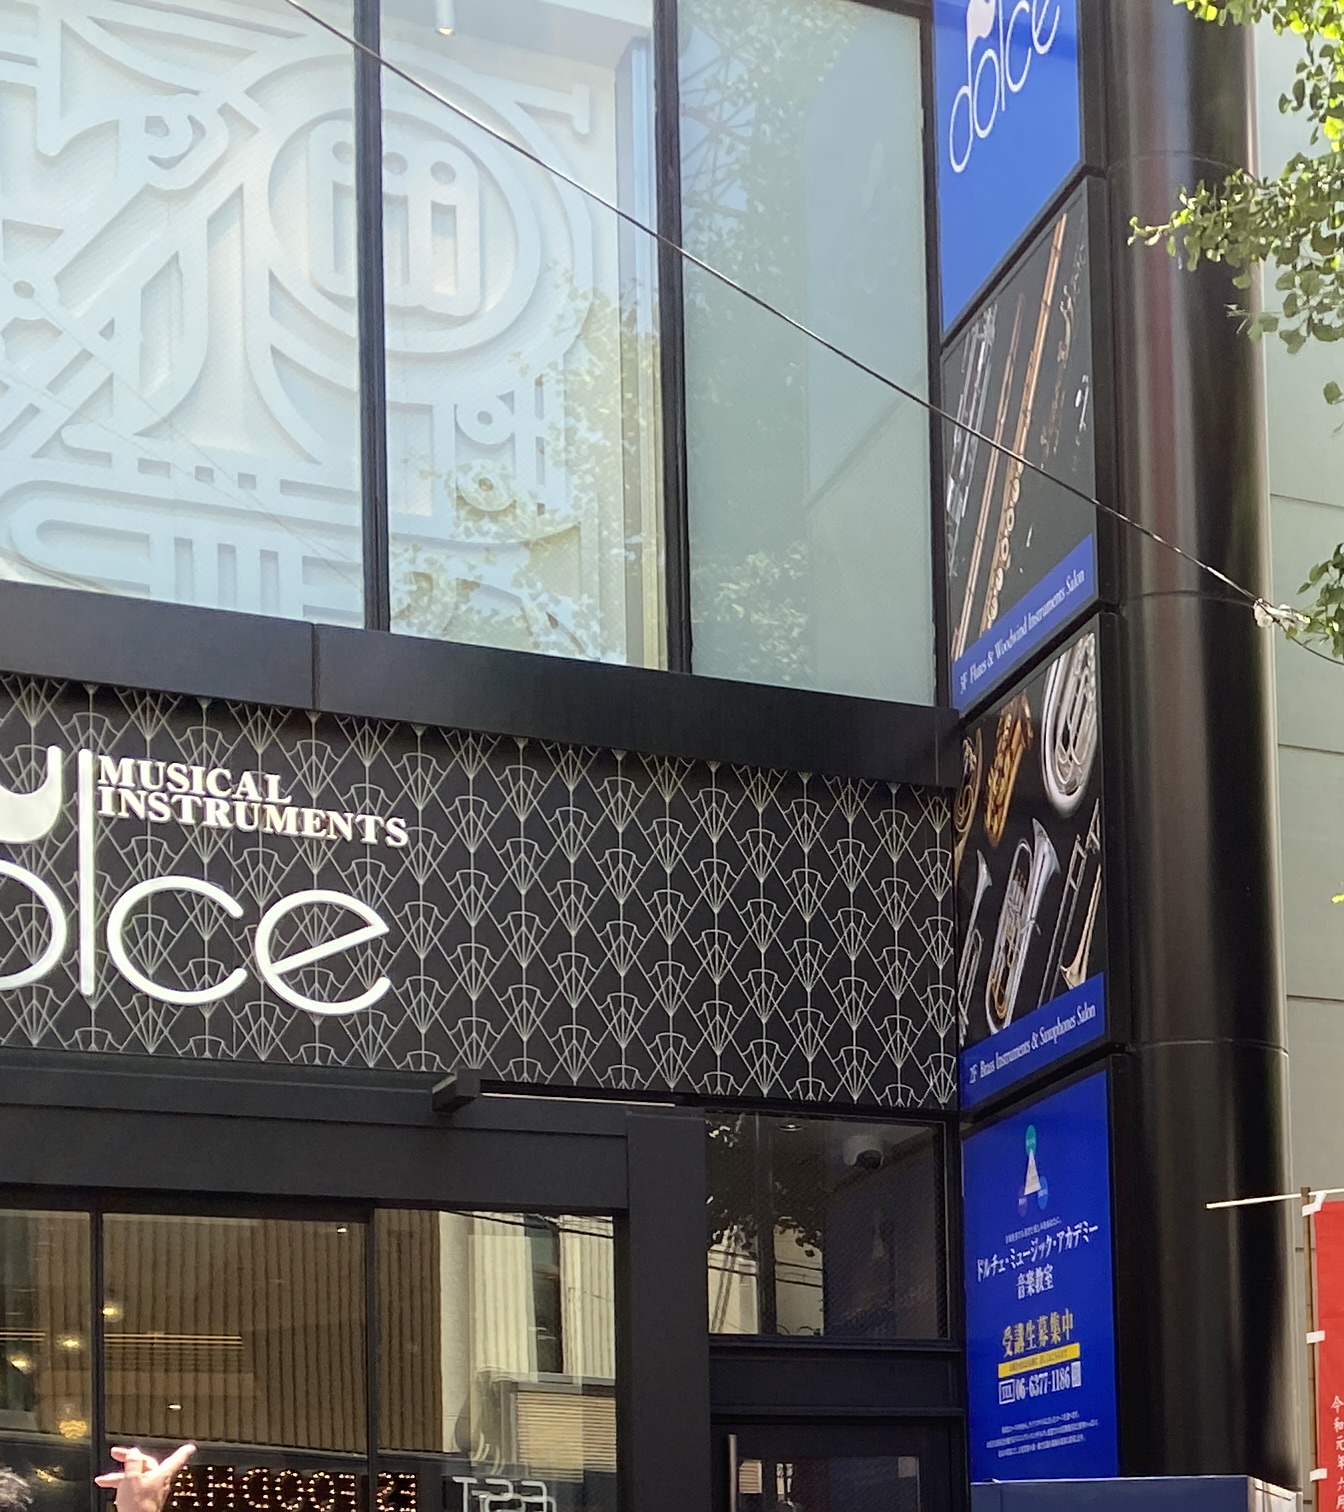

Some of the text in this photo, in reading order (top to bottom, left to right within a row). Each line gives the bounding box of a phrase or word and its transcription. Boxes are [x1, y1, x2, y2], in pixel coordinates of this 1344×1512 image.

[97, 754, 292, 805] MUSICAL
[97, 785, 410, 849] INSTRUMENTS
[1016, 1263, 1054, 1300] 音楽教室
[1002, 1307, 1075, 1359] 受講生募集中
